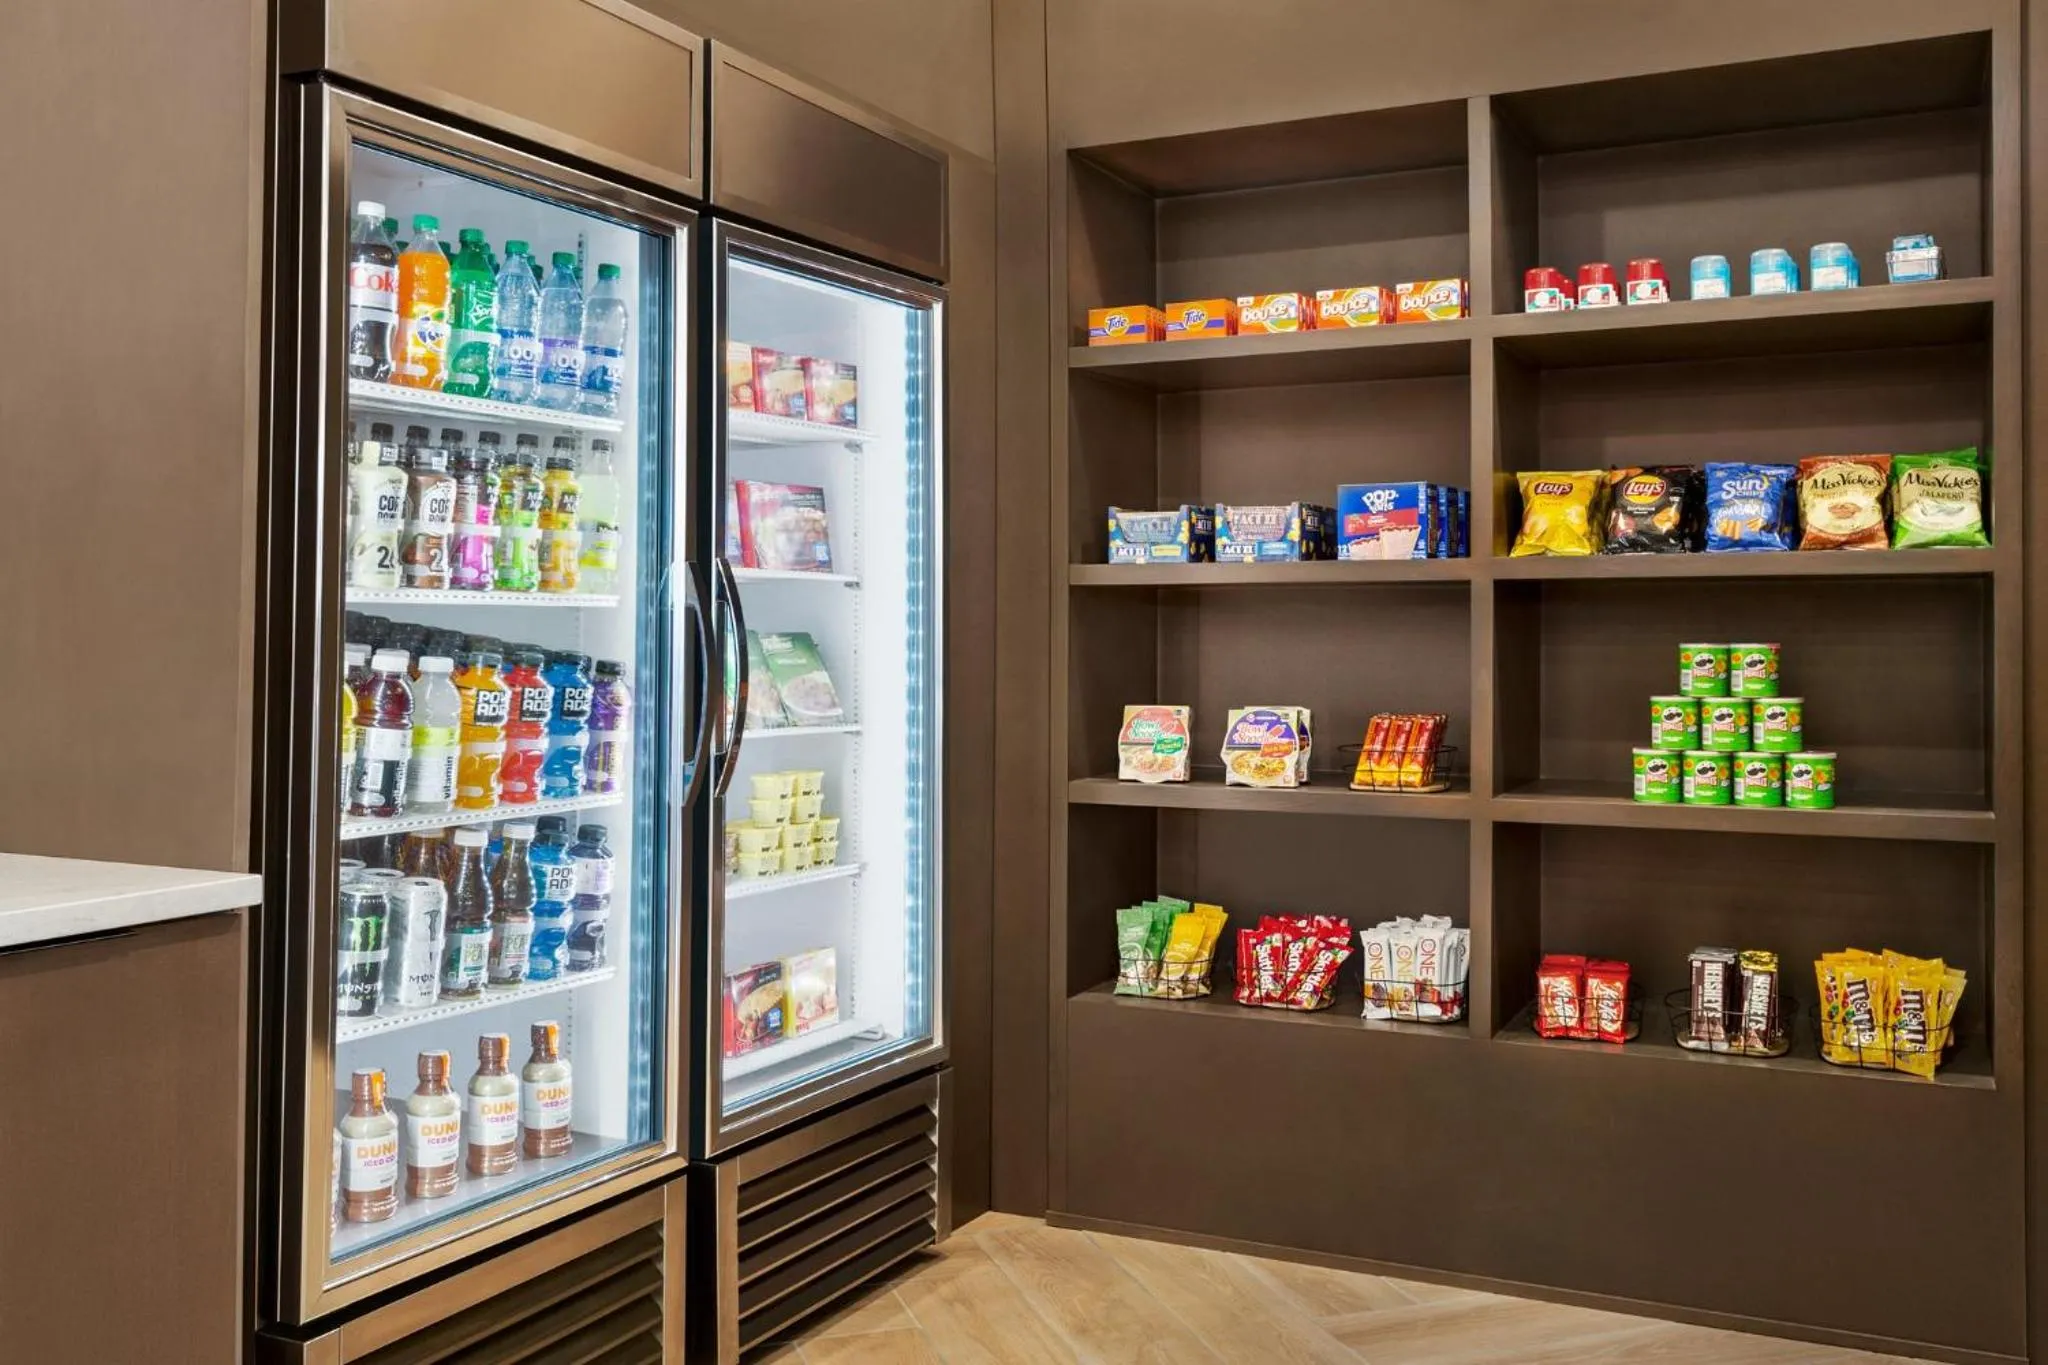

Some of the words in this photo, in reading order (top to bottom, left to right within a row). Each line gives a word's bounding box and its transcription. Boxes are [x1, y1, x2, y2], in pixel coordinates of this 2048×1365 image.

[1322, 296, 1369, 316] bounce
[1402, 289, 1449, 309] bounce
[1185, 309, 1205, 326] Tide
[1242, 302, 1287, 322] bounce
[1106, 315, 1127, 332] Tide
[1722, 479, 1766, 499] Sun
[1811, 476, 1841, 490] Miss
[1904, 472, 1935, 488] Miss
[1421, 938, 1437, 977] ONE
